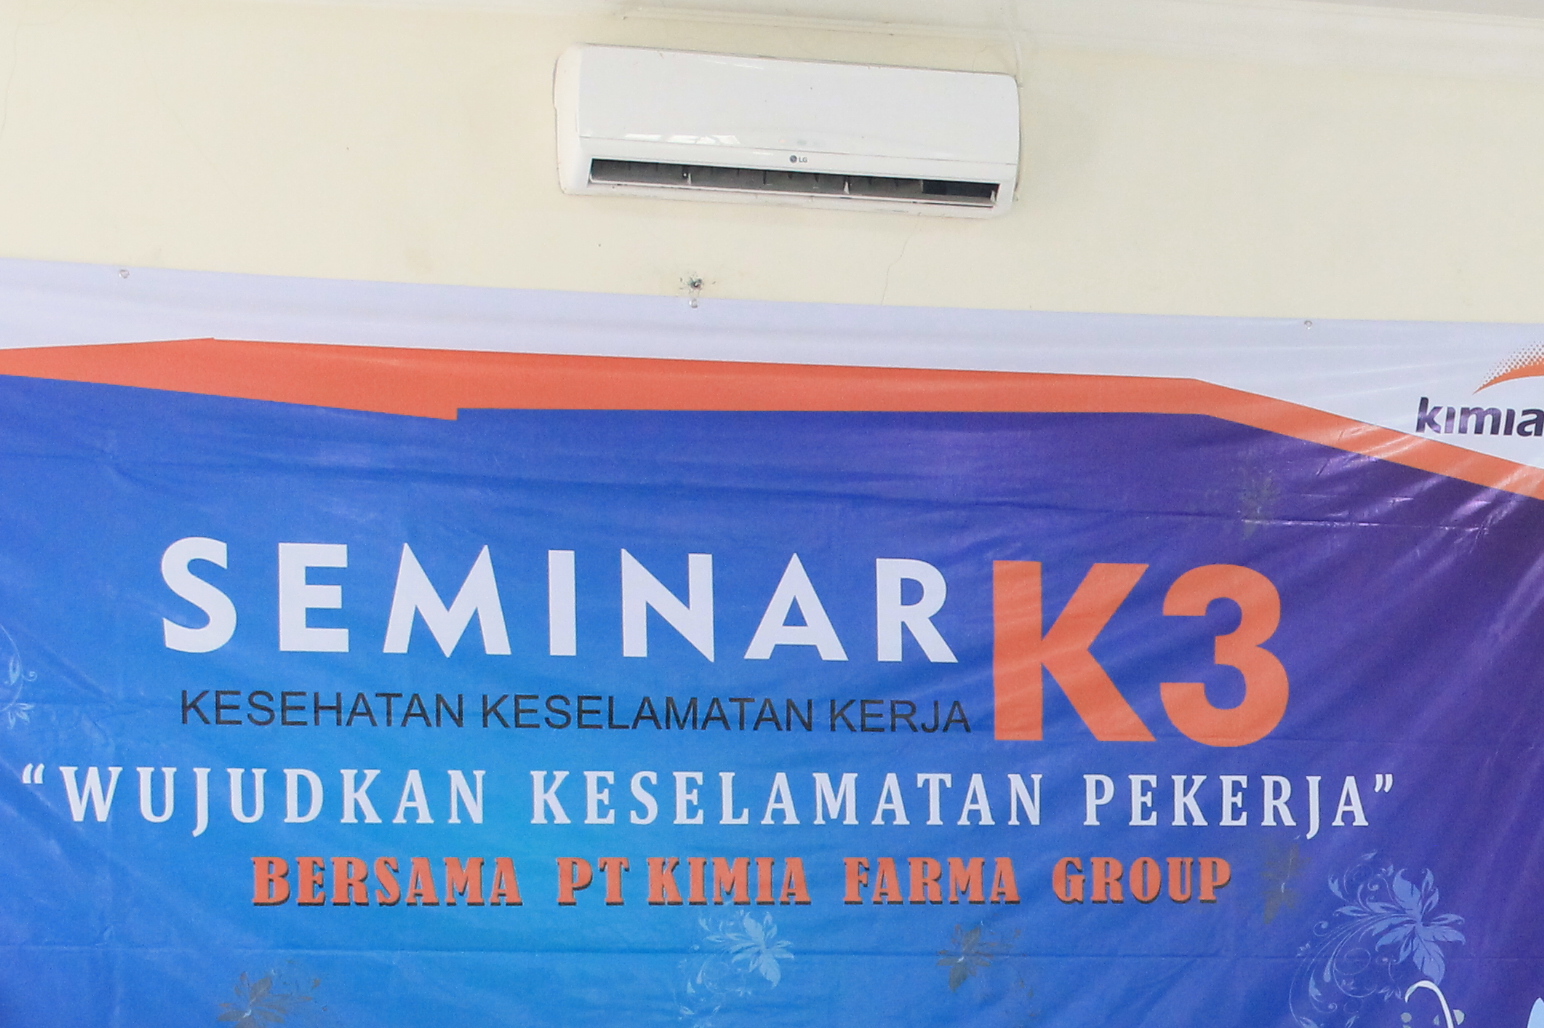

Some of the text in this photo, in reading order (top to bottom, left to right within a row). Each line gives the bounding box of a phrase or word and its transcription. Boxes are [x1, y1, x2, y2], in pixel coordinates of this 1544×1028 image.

[160, 536, 1290, 748] SEMINAR K3
[180, 689, 972, 734] KESEHATAN KESELAMATAN KERJA
[20, 762, 1394, 840] “WUJUDKAN KESELAMATAN PEKERJA”
[250, 856, 1232, 907] BERSAMA PT KIMIA FARMA GROUP
